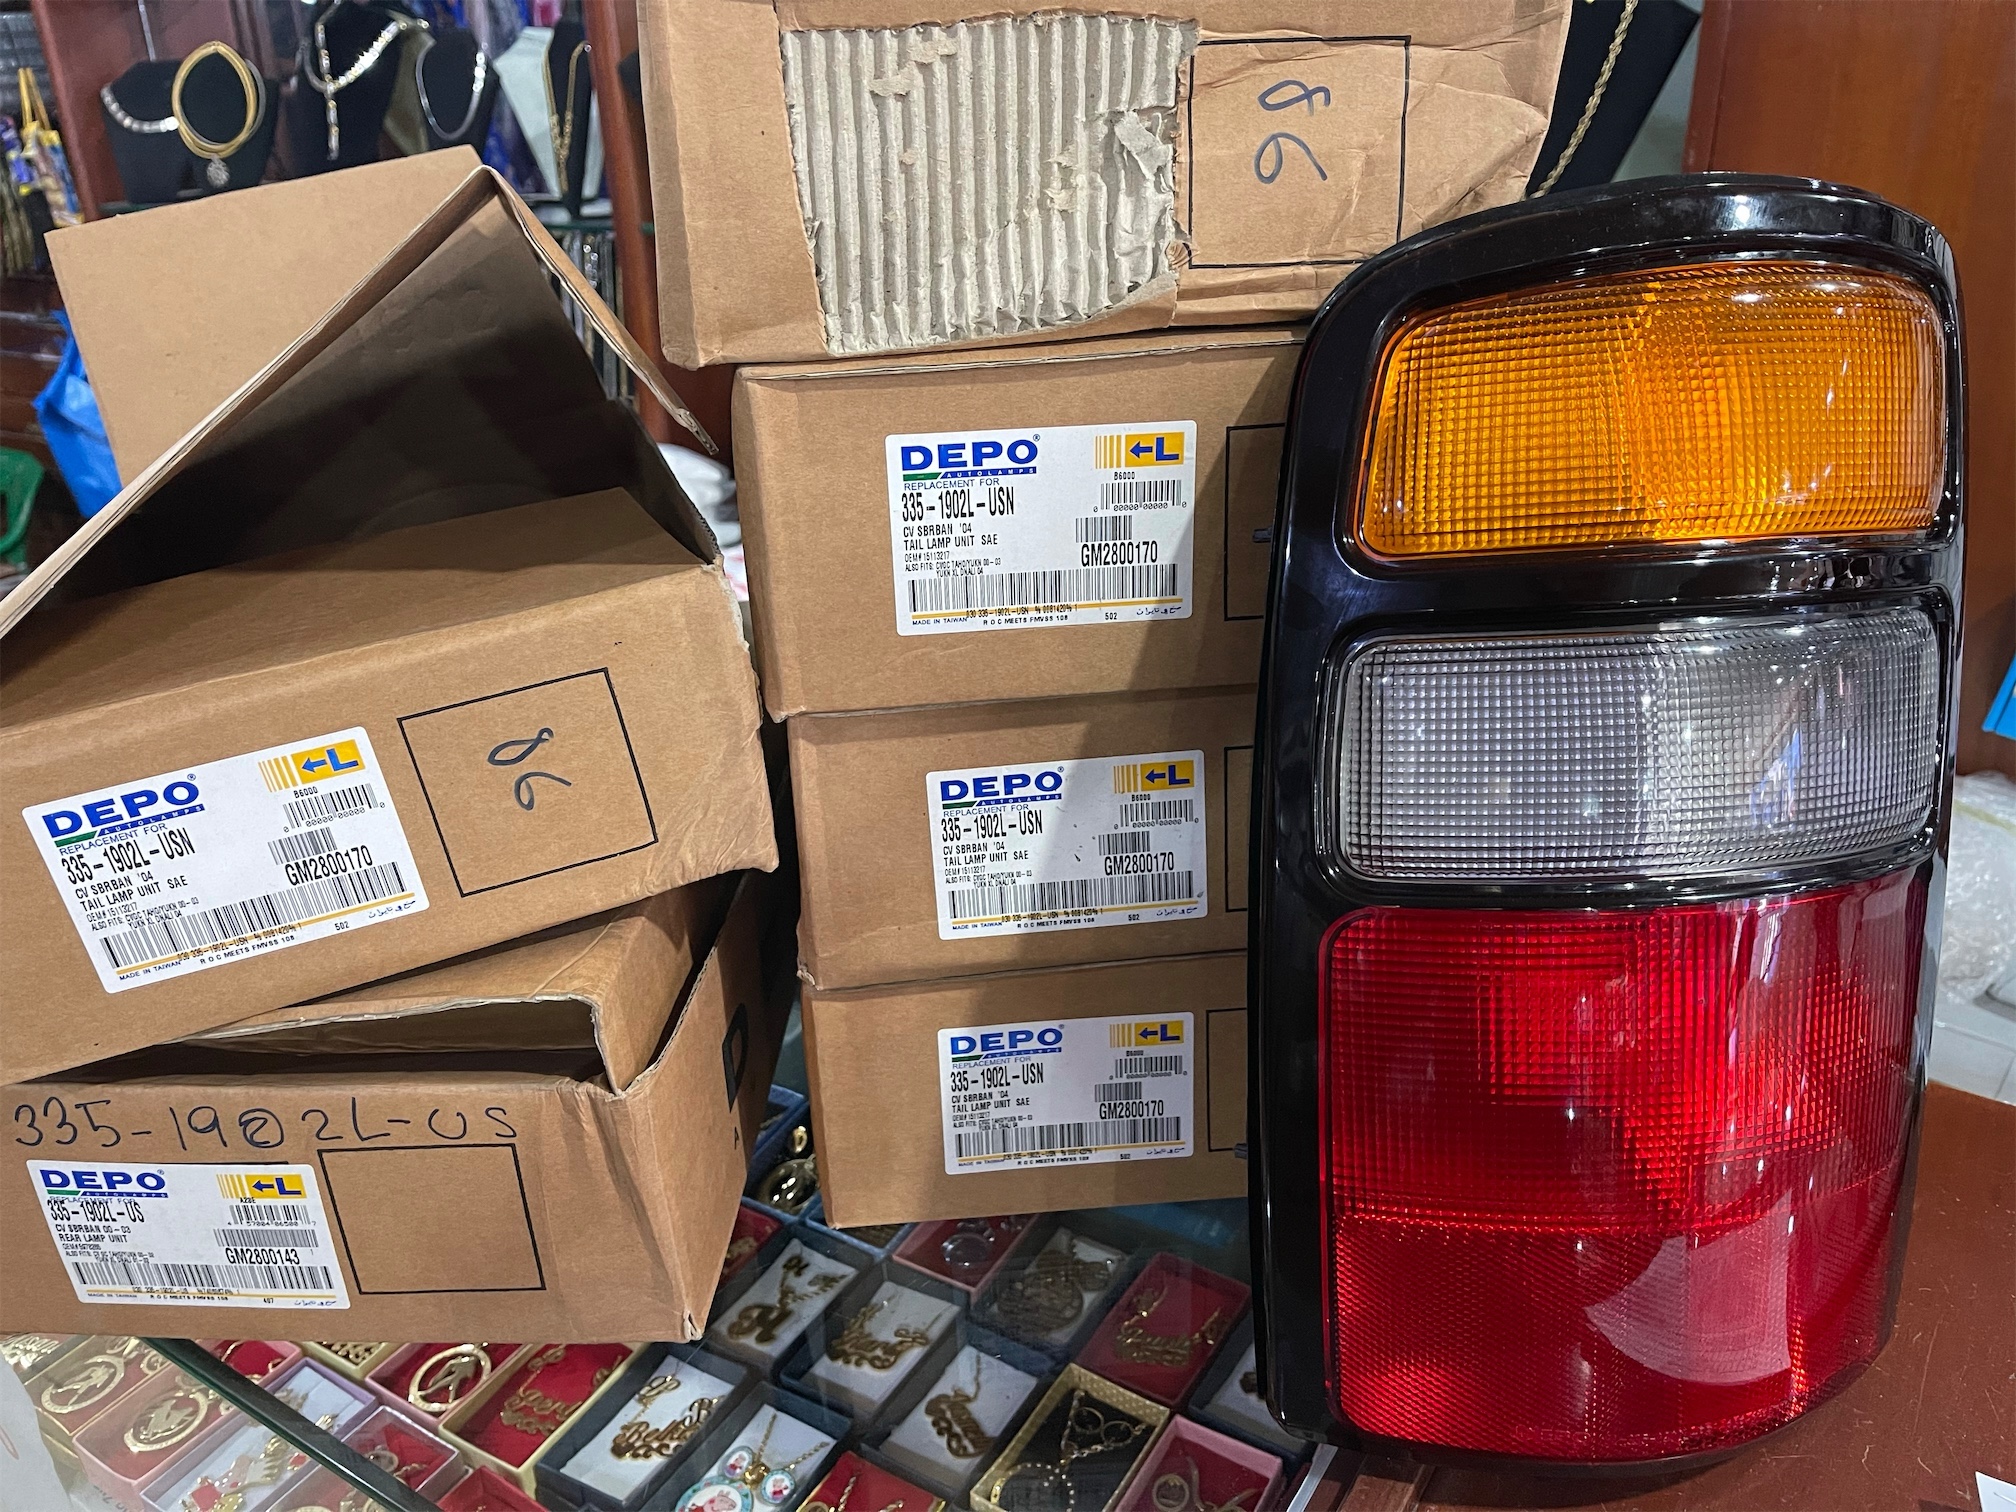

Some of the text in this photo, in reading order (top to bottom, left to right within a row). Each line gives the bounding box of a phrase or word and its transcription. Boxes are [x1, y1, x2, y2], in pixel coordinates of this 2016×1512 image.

[901, 439, 1038, 471] DEPO
[1156, 437, 1179, 461] L
[946, 468, 1035, 479] AUTOLAMPS
[904, 477, 1000, 491] REPLACEMENT FOR
[901, 486, 1014, 522] 335-1902L-USN
[903, 522, 972, 538] CV SBRBAN '04
[904, 533, 998, 551] TAIL LAMP UNIT SAE
[1081, 540, 1158, 567] GM2800170
[1105, 612, 1118, 620] 502
[326, 748, 359, 771] L
[1168, 765, 1190, 785] L
[940, 770, 1063, 801] DEPO
[42, 780, 200, 838] DEPO
[943, 803, 1029, 817] REPLACEMENT FOR
[980, 794, 1061, 806] AUTOLAMPS
[103, 805, 203, 835] AUTOLAMPS
[941, 809, 1043, 842] 335-1902L-USN
[59, 822, 169, 856] REPLACEMENT FOR
[943, 842, 1005, 855] CV SBRBAN '04
[61, 827, 196, 885] 335-1902L-USN
[284, 845, 373, 886] GM2800170
[943, 850, 1029, 867] TAIL LAMP UNIT SAE
[1104, 851, 1174, 876] GM2800170
[75, 870, 154, 899] CV SBRBAN '04
[80, 875, 189, 912] TAIL LAMP UNIT SAE
[334, 920, 349, 931] 502
[224, 947, 250, 959] MEETS
[252, 939, 279, 951] FMVSS
[119, 971, 141, 981] MADE
[153, 961, 182, 972] TAIWAN
[950, 1027, 1063, 1056] DEPO
[1160, 1024, 1180, 1041] L
[952, 1055, 1032, 1069] REPLACEMENT FOR
[950, 1062, 1044, 1092] 335-1902L-USN
[951, 1095, 961, 1104] CV
[963, 1091, 993, 1103] SBRBAN
[951, 1097, 1030, 1113] TAIL LAMP UNIT SAE
[1099, 1099, 1164, 1120] GM2800170
[39, 1169, 166, 1191] DEPO
[275, 1177, 302, 1195] L
[49, 1196, 113, 1204] REPLACEMENT
[47, 1199, 145, 1223] 335-1902L-US
[55, 1224, 66, 1233] CV
[68, 1224, 101, 1233] SBRBAN
[59, 1233, 128, 1243] REAR LAMP UNIT
[225, 1247, 300, 1265] GM2800143
